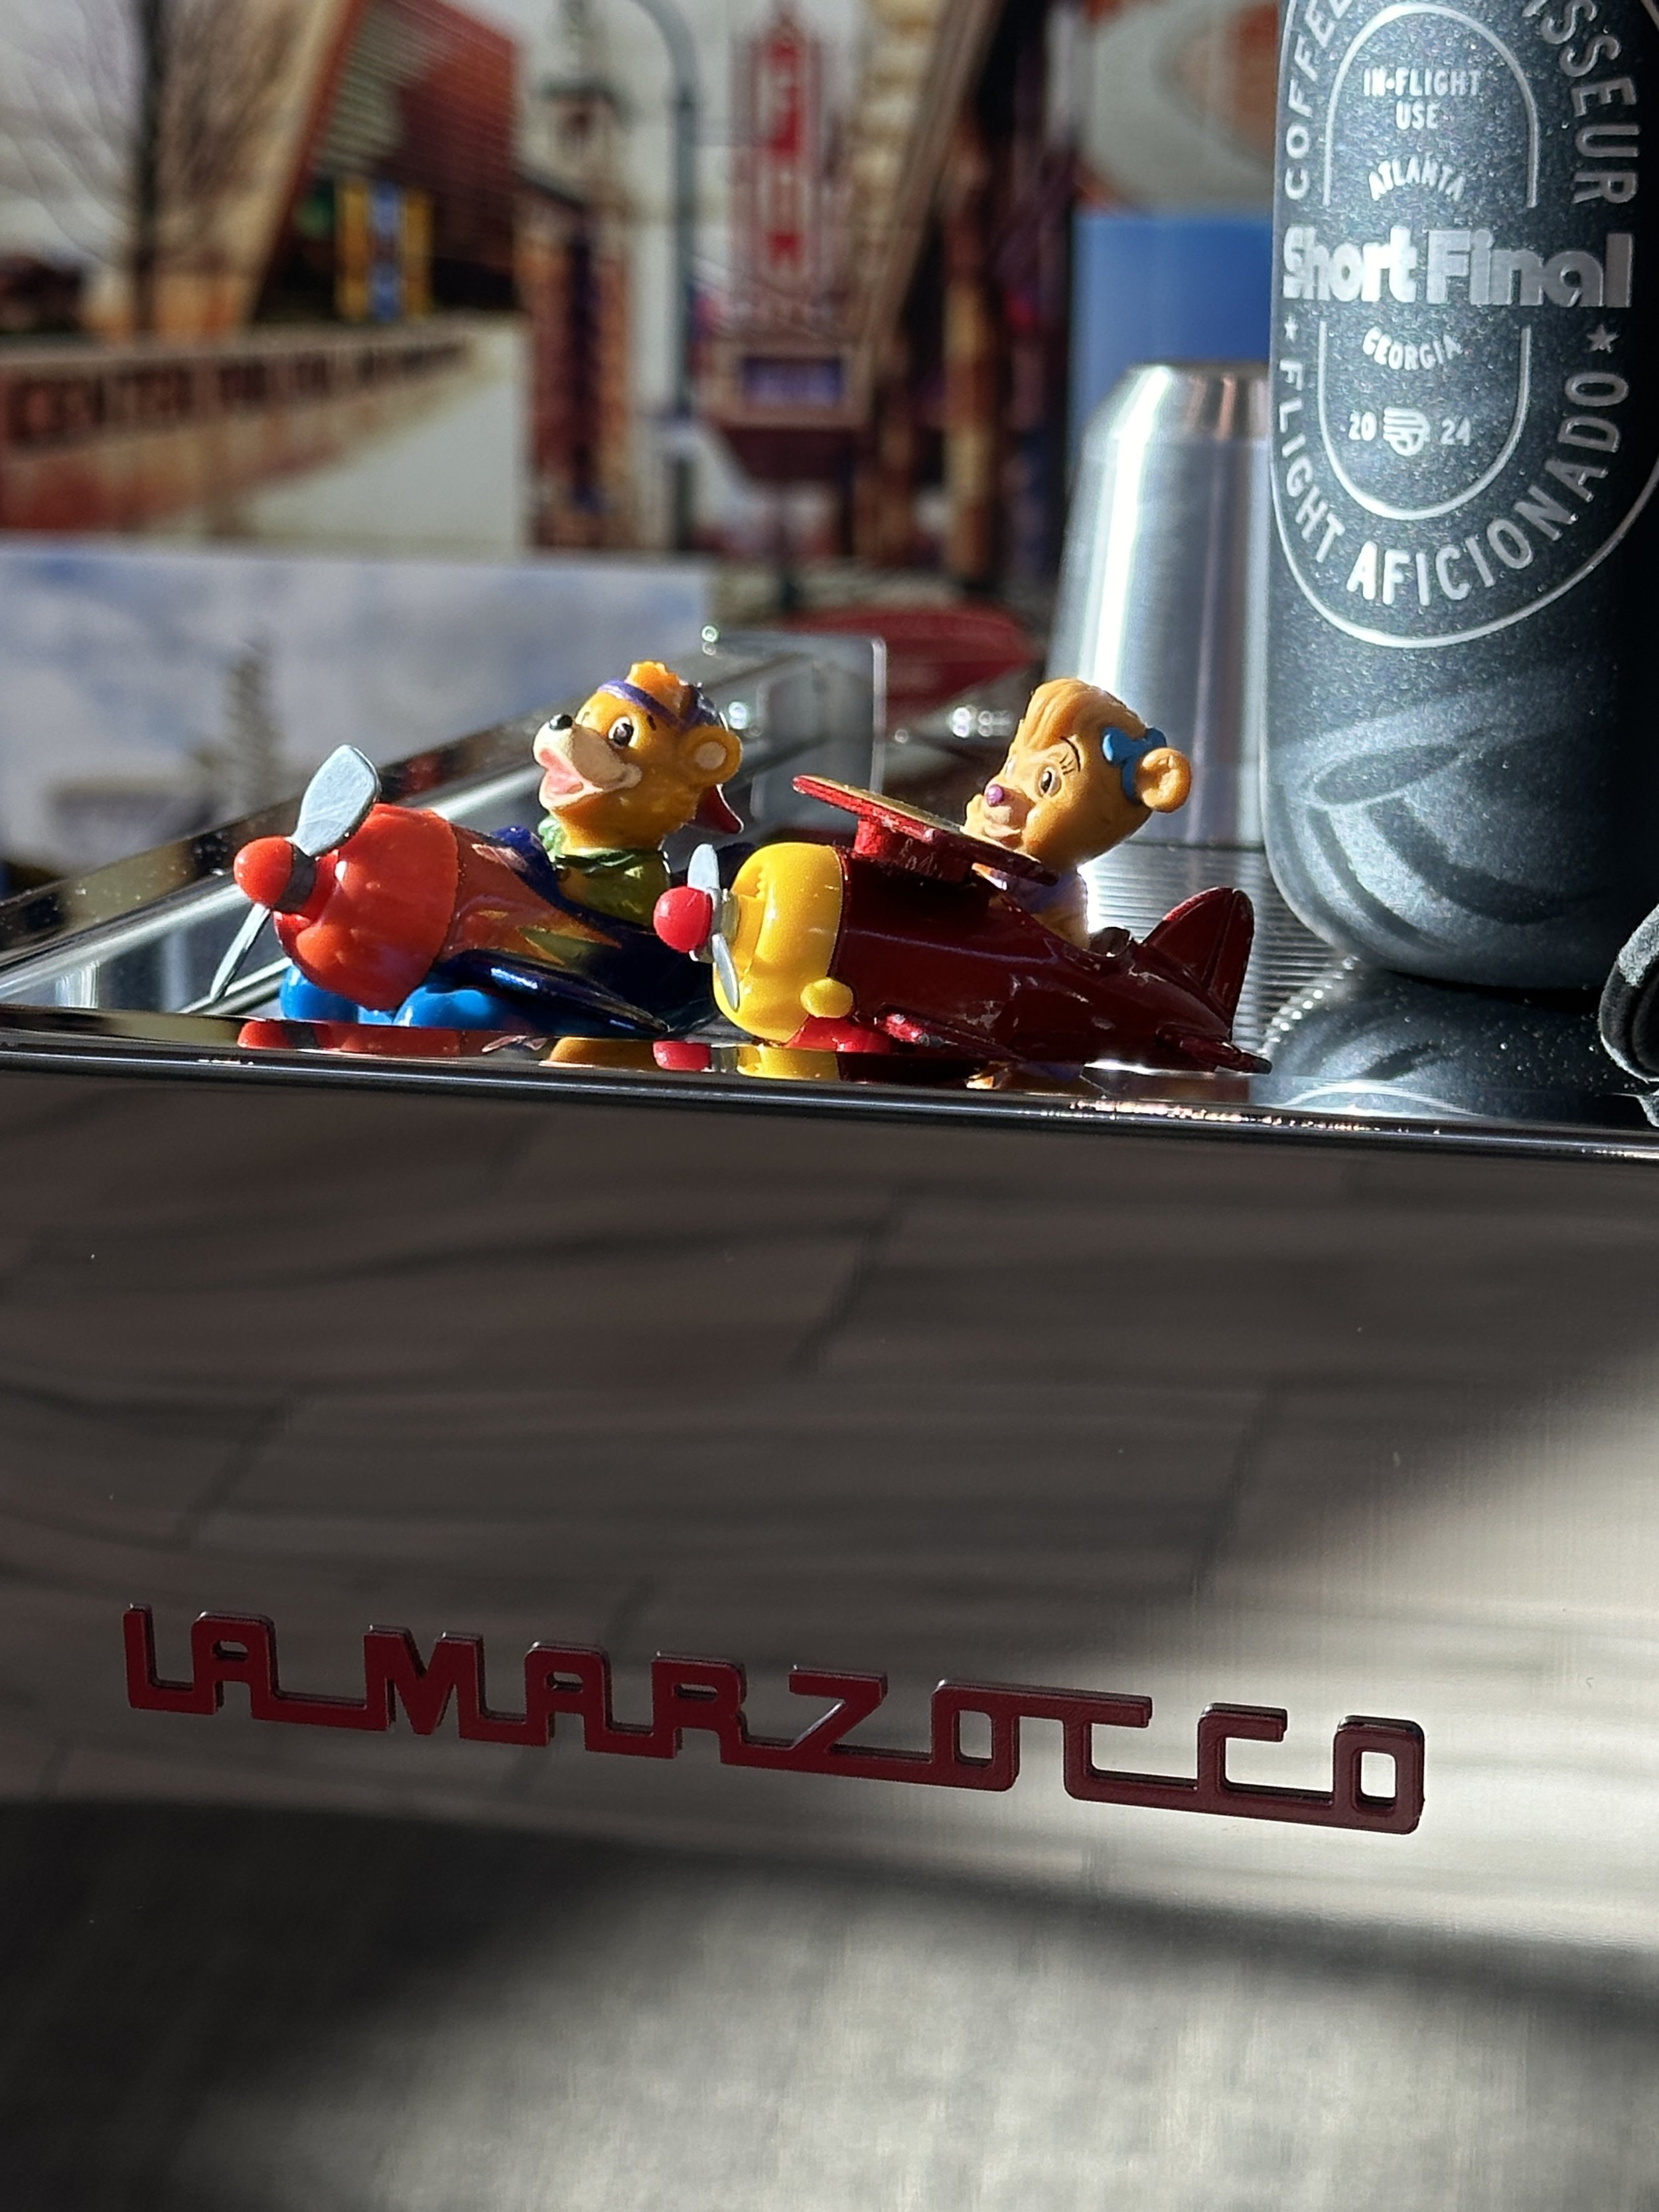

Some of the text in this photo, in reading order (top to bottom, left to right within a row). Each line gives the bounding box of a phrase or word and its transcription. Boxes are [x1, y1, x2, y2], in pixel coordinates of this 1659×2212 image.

[1396, 100, 1439, 130] USE
[1368, 157, 1464, 201] ATLANTA
[1283, 226, 1633, 308] Short Final
[1363, 326, 1462, 370] GEORGIA
[1348, 411, 1471, 446] 20 24
[1279, 360, 1630, 606] FLIGHT AFICIONADO
